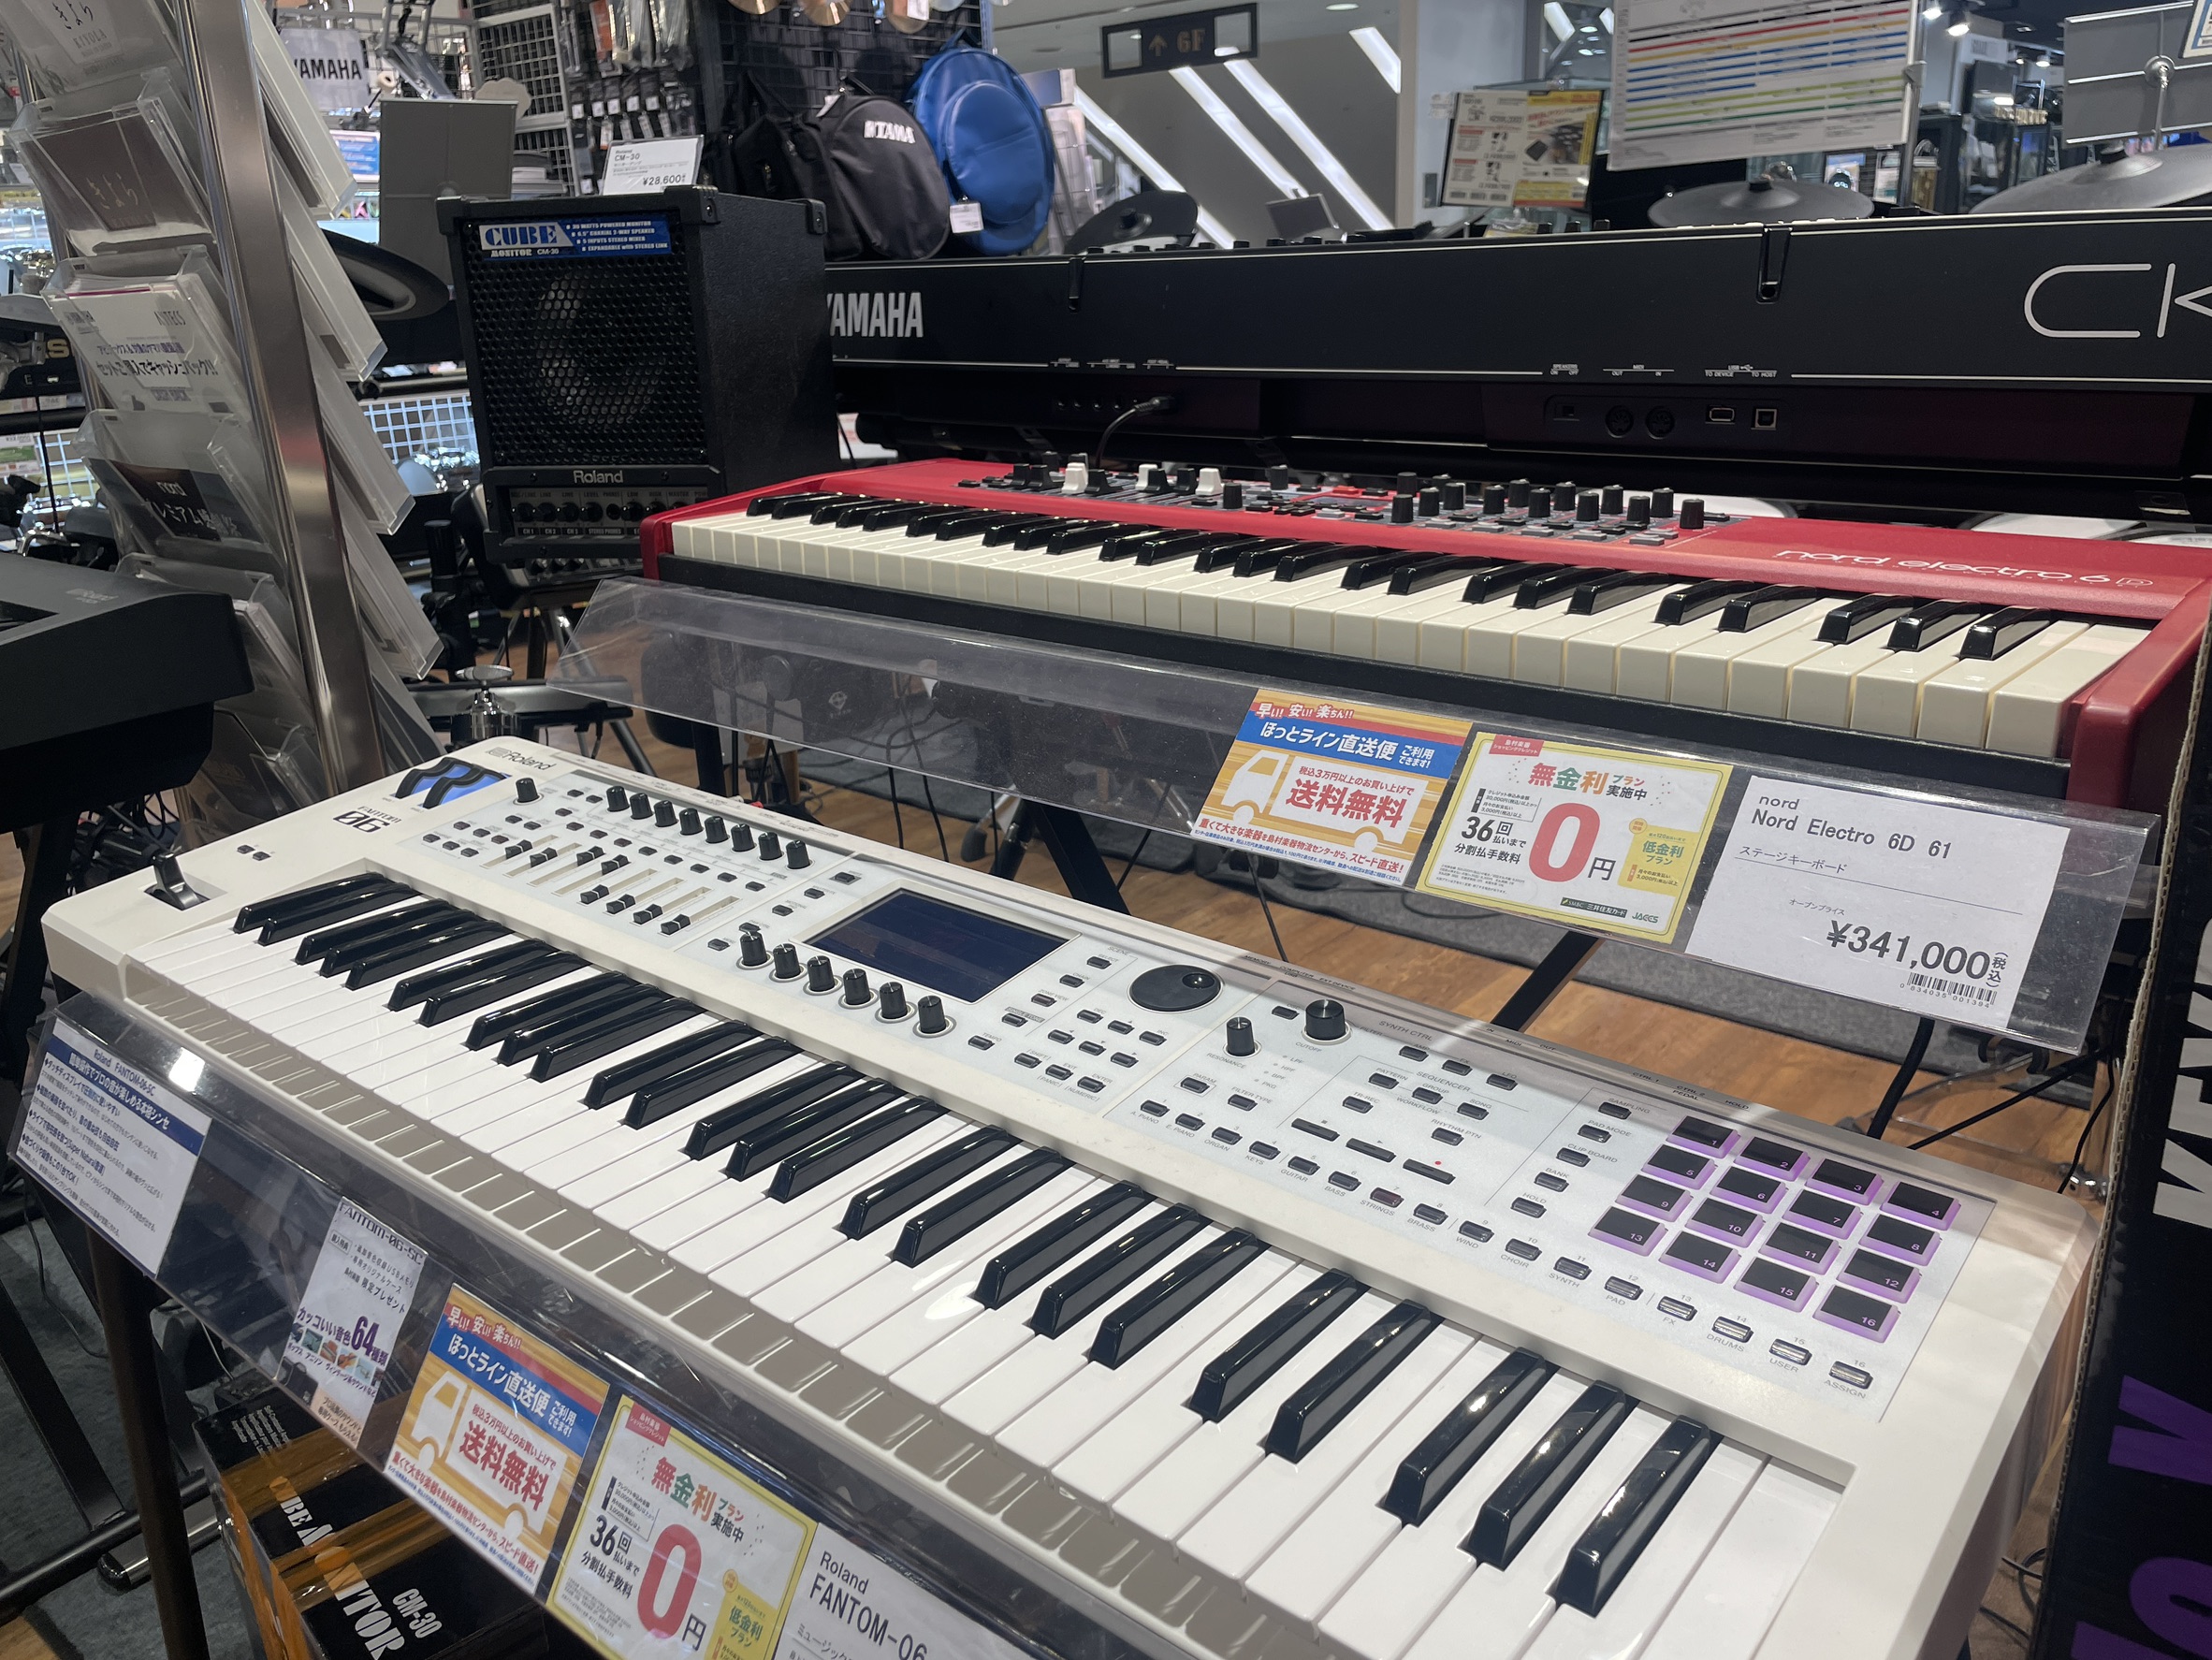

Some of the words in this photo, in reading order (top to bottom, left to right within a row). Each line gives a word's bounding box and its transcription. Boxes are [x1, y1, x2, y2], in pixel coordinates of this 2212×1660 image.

[485, 225, 558, 246] CUBE
[491, 249, 532, 257] MONITOR
[826, 292, 924, 338] AMAHA
[574, 470, 623, 484] Roland
[1777, 549, 1891, 565] nord
[1899, 560, 2073, 580] electro
[1260, 721, 1398, 761] ほっとライン直送便
[1402, 744, 1435, 760] ご利用
[503, 750, 556, 771] Roland
[1299, 766, 1415, 796] 税込3万円以上のお買い上げで
[1527, 762, 1609, 794] 無金利
[1612, 774, 1645, 787] プラン
[1606, 785, 1648, 801] 実施中
[1286, 779, 1407, 829] 送料無料
[1759, 796, 1800, 810] nord
[1461, 815, 1494, 842] 36
[1495, 821, 1514, 836] 回
[1751, 808, 1799, 832] Nord
[1807, 819, 1875, 846] Electro
[1888, 833, 1914, 852] 6D
[1928, 840, 1952, 860] 61
[1492, 835, 1527, 848] 払いまで
[1528, 802, 1601, 882] 0
[1588, 857, 1616, 881] 円
[1642, 840, 1684, 858] 低金利
[1454, 843, 1521, 865] 分割払手数料
[1646, 855, 1673, 866] プラン
[1739, 846, 1848, 874] ステージキーボード
[1789, 897, 1845, 916] オープンプライス
[1632, 912, 1659, 923] JACCS
[1108, 946, 1130, 956] SCENE
[1826, 920, 1990, 980] ¥341,000
[1910, 985, 1947, 999] 834035
[1952, 994, 1990, 1009] 001394
[982, 1032, 1002, 1042] TEMPO
[1360, 1026, 1383, 1038] FILTER
[1378, 1020, 1408, 1034] SYNTH
[1410, 1030, 1433, 1041] CTRL
[1295, 1041, 1322, 1053] CUTOFF
[1505, 1039, 1522, 1048] MIDI
[1206, 1053, 1246, 1070] RESONANCE
[94, 1049, 112, 1068] Roland
[114, 1059, 156, 1097] FANTOM-06-SC
[1092, 1073, 1113, 1084] ENTER
[1193, 1072, 1216, 1084] PARAM
[1375, 1067, 1408, 1081] PATTERN
[1416, 1070, 1471, 1092] SEQUENCER
[1632, 1071, 1652, 1081] CTRL
[1231, 1086, 1254, 1099] FILTER
[1254, 1095, 1273, 1104] TYPE
[1354, 1091, 1380, 1104] TR-REC
[1422, 1083, 1449, 1096] GROUP
[1672, 1090, 1699, 1101] PEDAL
[1396, 1096, 1440, 1115] WORKFLOW
[1469, 1098, 1492, 1109] SONG
[1608, 1098, 1651, 1114] SAMPLING
[1725, 1099, 1750, 1111] HOLD
[1140, 1114, 1159, 1125] PIANO
[1174, 1127, 1195, 1138] PIANO
[1431, 1118, 1465, 1134] RHYTHM
[1465, 1129, 1482, 1140] PTN
[1588, 1119, 1603, 1128] PAD
[1604, 1125, 1632, 1138] MODE
[1204, 1139, 1230, 1152] ORGAN
[1567, 1143, 1587, 1154] CLIP
[1588, 1150, 1618, 1164] BOARD
[1244, 1155, 1265, 1166] KEYS
[1280, 1168, 1308, 1183] GUITAR
[1546, 1167, 1570, 1179] BANK
[1324, 1186, 1346, 1197] BASS
[1522, 1192, 1547, 1204] HOLD
[1360, 1200, 1395, 1216] STRINGS
[1406, 1217, 1436, 1232] BRASS
[1728, 1224, 1741, 1233] 10
[339, 1201, 423, 1265] FANTOM-06-SC
[1630, 1233, 1643, 1242] 13
[1456, 1236, 1479, 1250] WIND
[1500, 1254, 1530, 1269] CHOIR
[1804, 1250, 1817, 1259] 11
[1703, 1260, 1716, 1269] 14
[1548, 1273, 1580, 1289] SYNTH
[1885, 1278, 1899, 1288] 12
[361, 1277, 405, 1314] 限定プレゼント
[1780, 1287, 1794, 1296] 15
[1606, 1294, 1626, 1306] PAD
[1663, 1317, 1677, 1326] FX
[1861, 1317, 1876, 1326] 16
[297, 1306, 389, 1366] カッコいい音色64種類
[1706, 1333, 1745, 1352] DRUMS
[1769, 1358, 1799, 1374] USER
[447, 1333, 551, 1418] ほっとライン直送便
[552, 1400, 577, 1426] ご利用
[1824, 1380, 1867, 1400] ASSIGN
[472, 1404, 557, 1469] 税込3万円以上のお買い上げで
[459, 1420, 550, 1512] 送料無料
[649, 1456, 718, 1523] 無金利
[718, 1497, 745, 1522] プラン
[589, 1514, 617, 1555] 36
[618, 1531, 633, 1555] 回
[710, 1512, 745, 1544] 実施中
[612, 1551, 641, 1577] 払いまで
[580, 1550, 633, 1600] 分割払手数料
[820, 1551, 869, 1594] Roland
[637, 1523, 702, 1639] 0
[681, 1612, 707, 1652] 円
[392, 1588, 443, 1638] CM-30
[809, 1572, 928, 1660] FANTOM-06
[729, 1606, 763, 1641] 低金利
[730, 1626, 752, 1649] プラン
